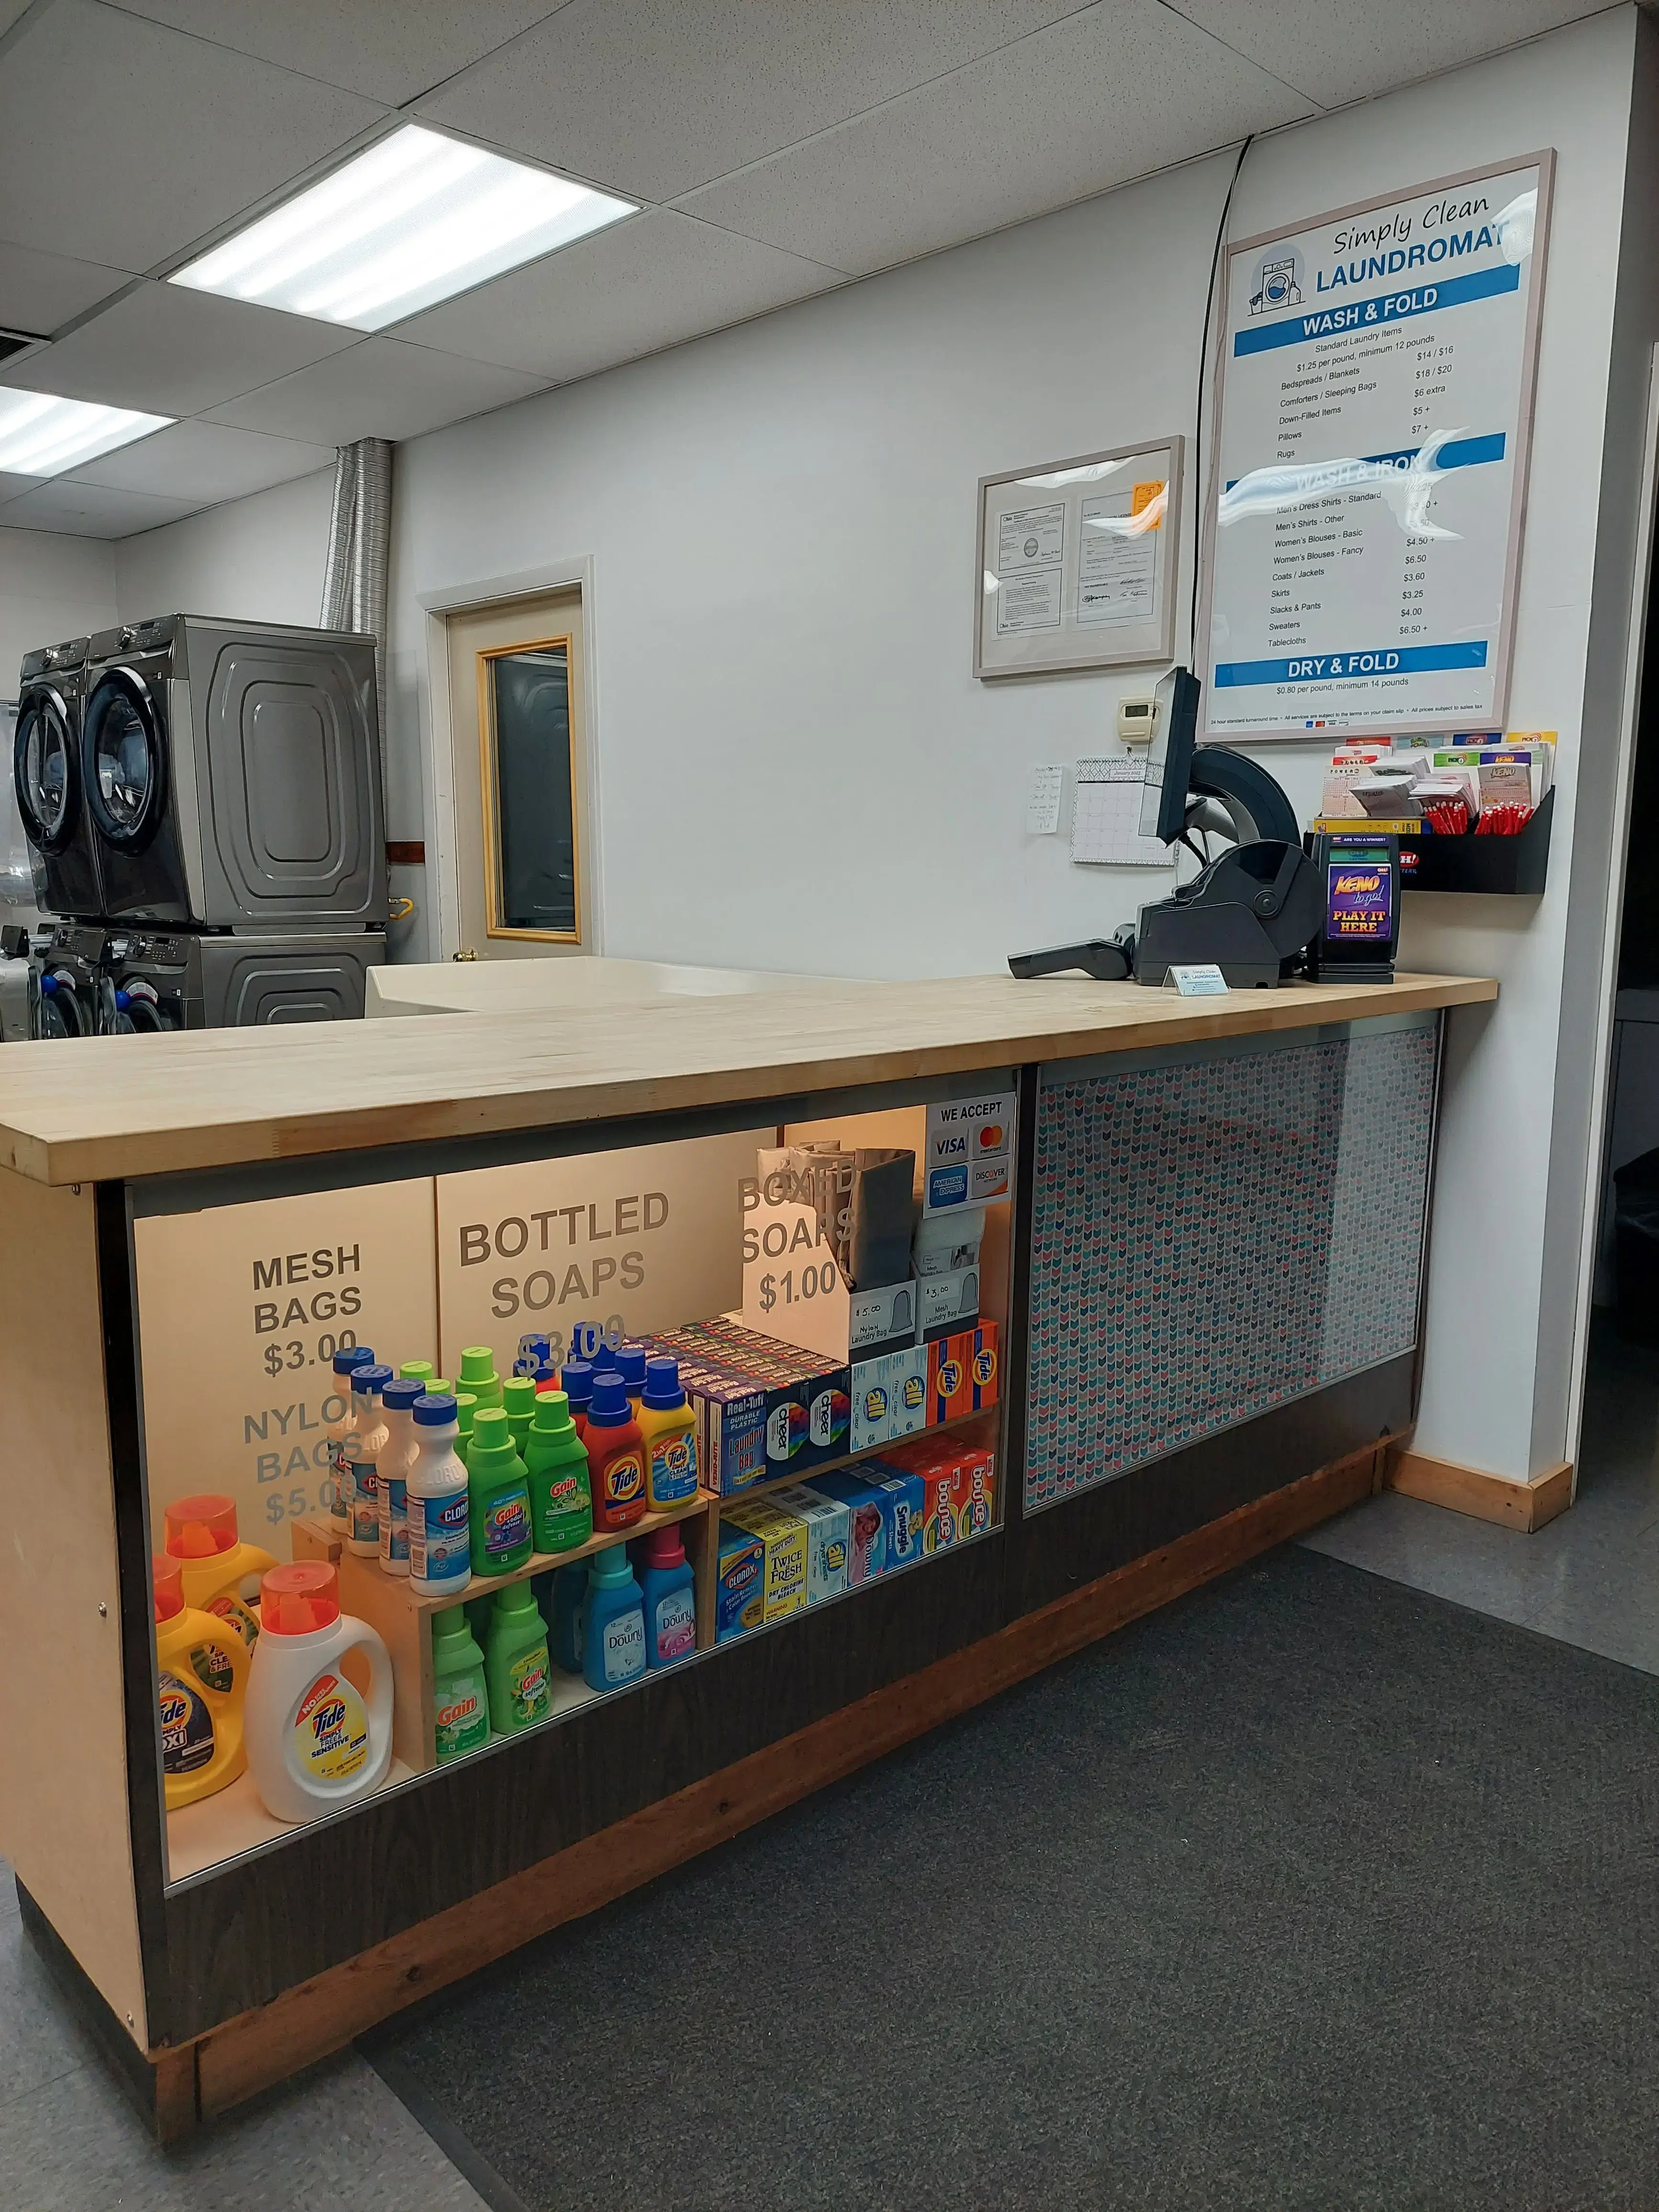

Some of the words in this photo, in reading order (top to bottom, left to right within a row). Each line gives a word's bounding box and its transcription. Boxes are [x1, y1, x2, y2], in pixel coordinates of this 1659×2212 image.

[1333, 213, 1411, 255] Simply
[1422, 197, 1489, 230] Clean
[1303, 308, 1359, 335] WASH
[1365, 302, 1378, 321] &
[1384, 288, 1437, 317] FOLD
[1316, 338, 1348, 353] Standard
[1349, 332, 1380, 345] Laundry
[1382, 327, 1402, 338] Items
[1296, 361, 1316, 373] $1.25
[1318, 359, 1330, 369] per
[1332, 353, 1356, 366] pound,
[1359, 345, 1393, 358] minimum
[1395, 341, 1404, 350] 12
[1406, 335, 1435, 349] pounds
[1417, 352, 1431, 361] $14
[1438, 345, 1454, 356] $16
[1281, 375, 1322, 390] Bedspreads
[1329, 367, 1360, 380] Blankets
[1416, 369, 1430, 379] $18
[1437, 365, 1452, 376] $20
[1280, 394, 1318, 408] Comforters
[1325, 386, 1356, 398] Sleeping
[1358, 382, 1377, 391] Bags
[1414, 388, 1424, 398] $6
[1426, 385, 1446, 395] extra
[1279, 410, 1320, 425] Down-Filled
[1322, 407, 1341, 416] Items
[1413, 407, 1423, 416] $5
[1278, 431, 1302, 442] Pillows
[1411, 425, 1422, 434] $7
[1277, 449, 1295, 459] Rugs
[1277, 504, 1297, 514] Men's
[1299, 501, 1319, 511] Dress
[1321, 498, 1341, 507] Shirts
[1349, 491, 1382, 503] Standard
[1276, 521, 1296, 531] Men's
[1297, 519, 1317, 528] Shirts
[1325, 514, 1345, 524] Other
[1274, 537, 1306, 548] Women's
[1308, 533, 1336, 543] Blouses
[1343, 529, 1362, 539] Basic
[1406, 536, 1428, 547] $4.50
[1273, 554, 1305, 564] Women's
[1307, 550, 1335, 560] Blouses
[1341, 546, 1364, 557] Fancy
[1405, 554, 1427, 564] $6.50
[1272, 572, 1292, 581] Coats
[1298, 568, 1325, 578] Jackets
[1404, 572, 1425, 582] $3.60
[1271, 589, 1290, 598] Skirts
[1402, 590, 1424, 600] $3.25
[1270, 605, 1292, 614] Slacks
[1301, 602, 1321, 611] Pants
[1401, 608, 1422, 618] $4.00
[1269, 621, 1300, 631] Sweaters
[1399, 625, 1421, 635] $6.50
[1268, 637, 1306, 647] Tablecloths
[1288, 658, 1326, 678] DRY
[1330, 657, 1343, 674] &
[1349, 653, 1399, 673] FOLD
[1277, 686, 1295, 695] $0.80
[1310, 683, 1334, 693] pound,
[1336, 680, 1369, 690] minimum
[1382, 678, 1409, 687] pounds
[1491, 767, 1516, 778] KENO
[1334, 875, 1380, 896] KENO
[1333, 910, 1368, 921] PLAY
[1370, 910, 1386, 921] IT
[1340, 922, 1377, 932] HERE
[940, 1108, 958, 1122] WE
[960, 1101, 1003, 1119] ACCEPT
[935, 1137, 966, 1155] VISA
[933, 1176, 963, 1188] AMERICAN
[975, 1168, 1005, 1181] DISCOVER
[737, 1159, 857, 1214] BOXED
[940, 1184, 964, 1195] EXPRESS
[460, 1192, 669, 1267] BOTTLED
[742, 1207, 857, 1264] SOAPS
[252, 1243, 361, 1291] MESH
[491, 1250, 645, 1319] SOAPS
[759, 1261, 837, 1314] $1.00
[254, 1286, 362, 1334] BAGS
[926, 1312, 947, 1325] Laundry
[947, 1310, 957, 1318] Bag
[935, 1304, 949, 1314] Mesh
[852, 1329, 875, 1344] Laundry
[876, 1328, 887, 1337] Bag
[264, 1329, 357, 1378] $3.00
[517, 1314, 625, 1382] $3.00
[976, 1351, 992, 1382] Tide
[941, 1362, 957, 1393] Tide
[905, 1378, 923, 1405] all
[727, 1393, 764, 1416] Real-Tuff
[867, 1390, 886, 1418] all
[243, 1386, 373, 1444] NYLON
[730, 1410, 760, 1425] DURABLE
[730, 1417, 758, 1430] PLASTIC
[820, 1394, 831, 1436] cheer
[778, 1407, 789, 1450] cheer
[729, 1424, 763, 1457] Laundry
[256, 1431, 363, 1483] BAGS
[668, 1448, 687, 1468] Tide
[738, 1450, 754, 1471] Bag
[611, 1465, 638, 1497] Tide
[669, 1466, 687, 1476] CLEAN
[551, 1477, 576, 1497] Gain
[971, 1465, 985, 1525] bounce
[266, 1474, 358, 1524] $5.00
[937, 1478, 951, 1540] bounce
[495, 1503, 520, 1525] Gain
[502, 1521, 520, 1530] defense
[896, 1505, 909, 1554] Snuggle
[769, 1544, 784, 1555] HEAVY
[784, 1536, 796, 1547] DUTY
[863, 1534, 874, 1578] Downy
[771, 1549, 803, 1570] TWICE
[828, 1545, 845, 1569] all
[728, 1563, 755, 1589] CLOROX
[771, 1562, 802, 1584] FRESH
[768, 1590, 779, 1598] DRY
[780, 1578, 804, 1594] CHLORINE
[777, 1587, 796, 1601] BLEACH
[663, 1608, 691, 1629] Downy
[609, 1627, 642, 1649] Downy
[522, 1668, 542, 1691] Gain
[301, 1699, 316, 1714] NO
[438, 1696, 476, 1726] Gain
[313, 1701, 346, 1739] Tide
[320, 1728, 342, 1743] SIMPLY
[311, 1735, 350, 1759] SENSITIVE
